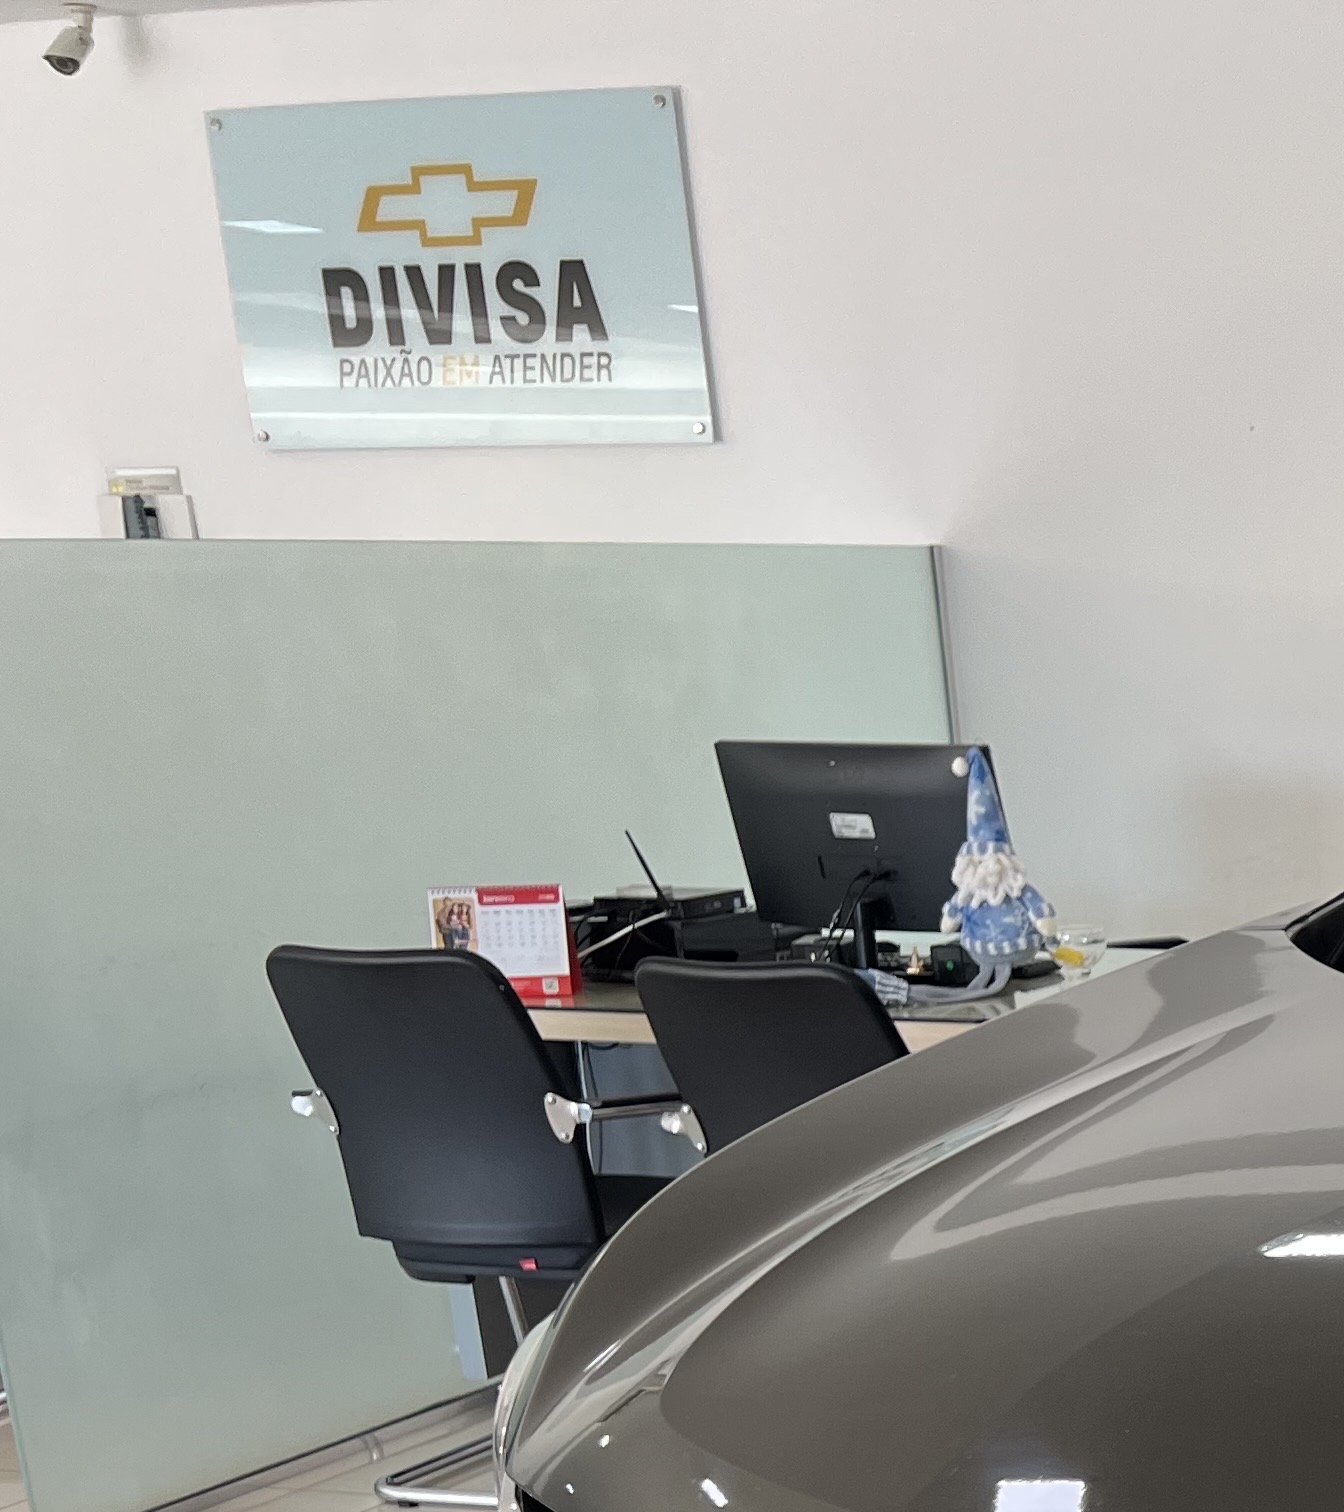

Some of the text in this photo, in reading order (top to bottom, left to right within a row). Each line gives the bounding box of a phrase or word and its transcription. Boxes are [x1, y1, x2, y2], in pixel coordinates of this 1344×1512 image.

[320, 257, 609, 349] DIVISA
[339, 348, 613, 390] PAIXÃO EM ATENDER
